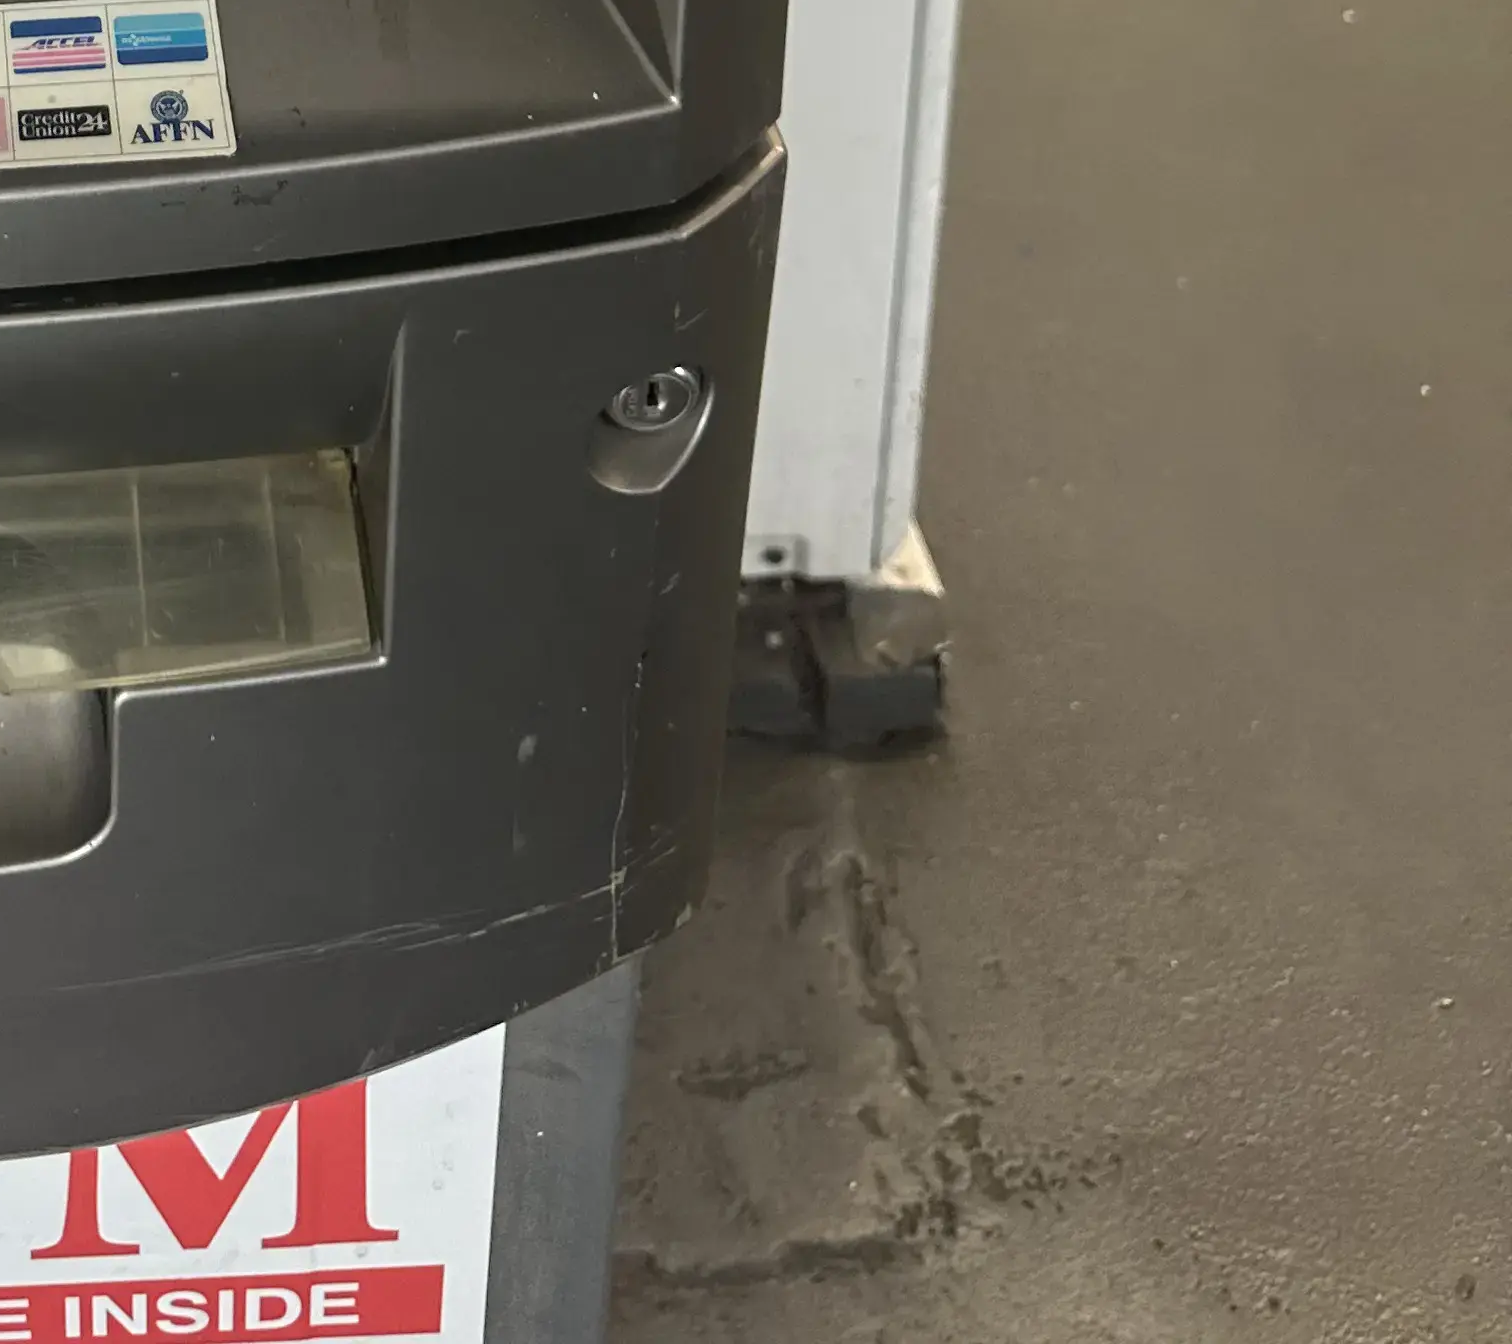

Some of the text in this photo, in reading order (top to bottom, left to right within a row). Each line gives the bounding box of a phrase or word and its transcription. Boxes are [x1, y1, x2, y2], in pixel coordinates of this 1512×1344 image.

[20, 111, 77, 127] Credit
[76, 111, 108, 132] 24
[21, 124, 78, 139] Union
[130, 118, 215, 145] AFFN
[65, 1281, 360, 1339] INSIDE
